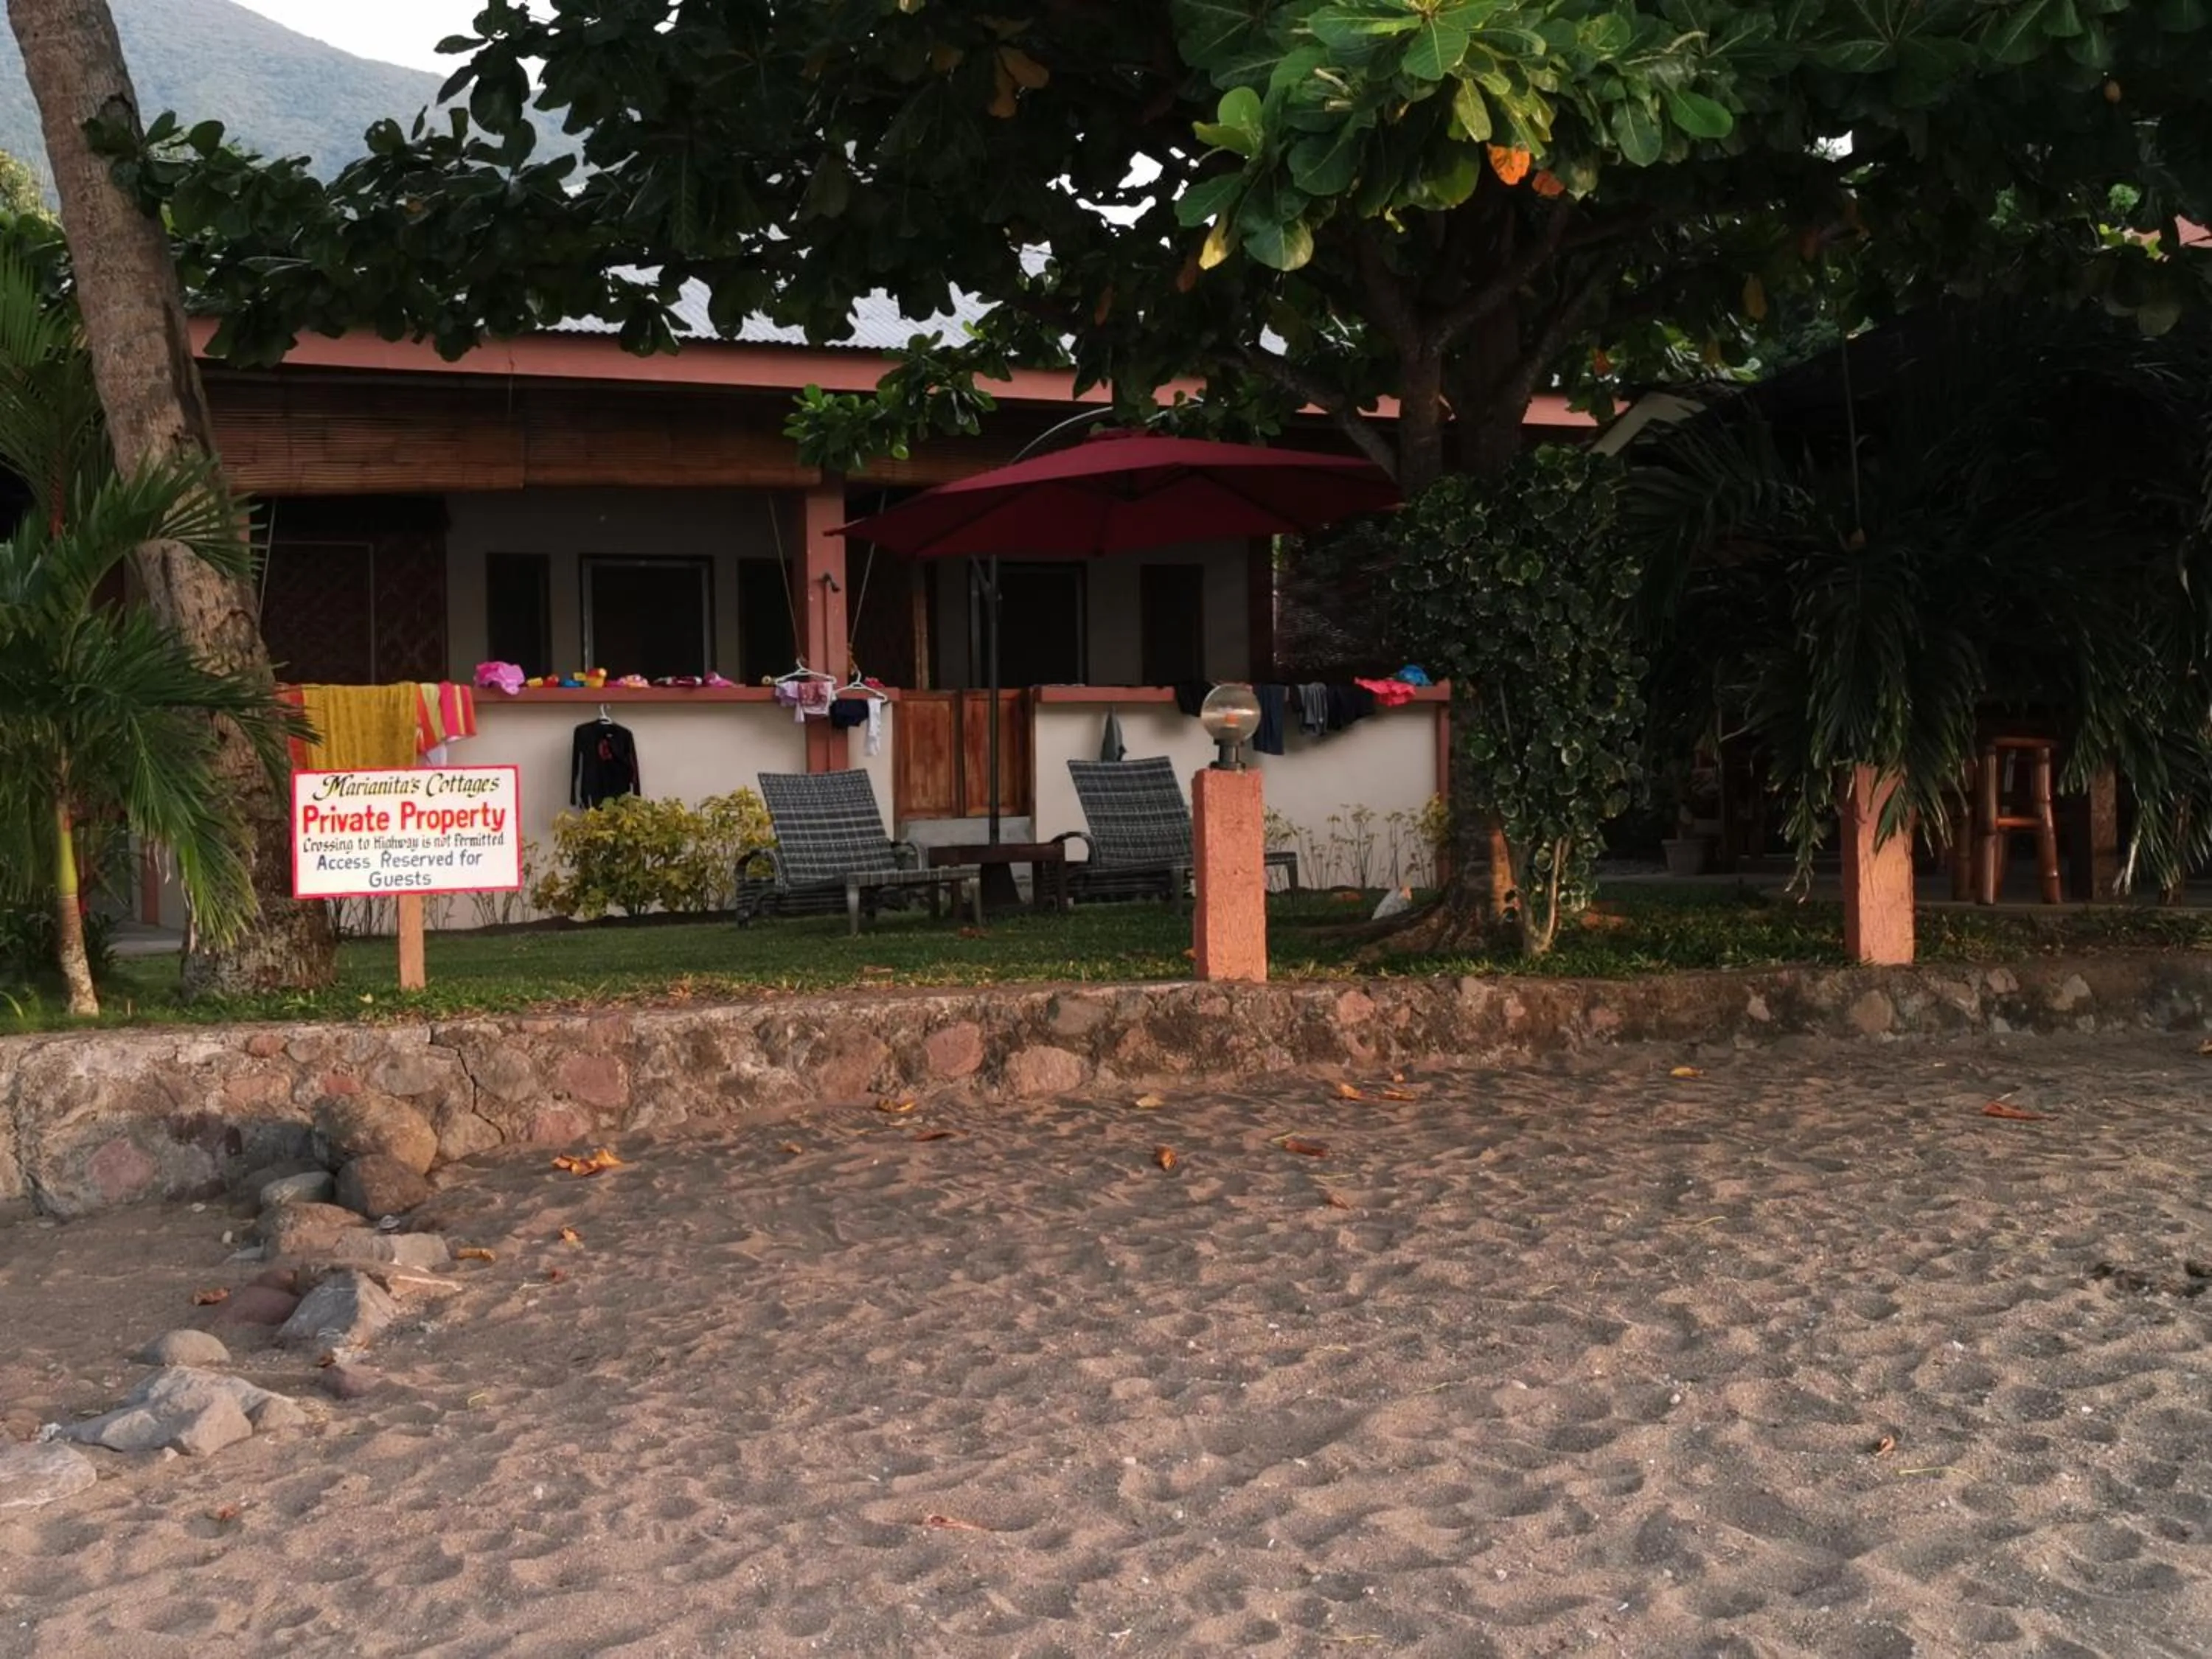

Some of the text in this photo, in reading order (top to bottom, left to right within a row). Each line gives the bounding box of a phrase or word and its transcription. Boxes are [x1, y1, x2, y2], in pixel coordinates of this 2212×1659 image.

[313, 773, 500, 801] Marianita's Cottages
[302, 801, 506, 834] Private Property
[303, 832, 504, 854] Crossing to Highway is not Permitted
[316, 849, 482, 871] Access Reserved for
[369, 872, 432, 888] Guests
